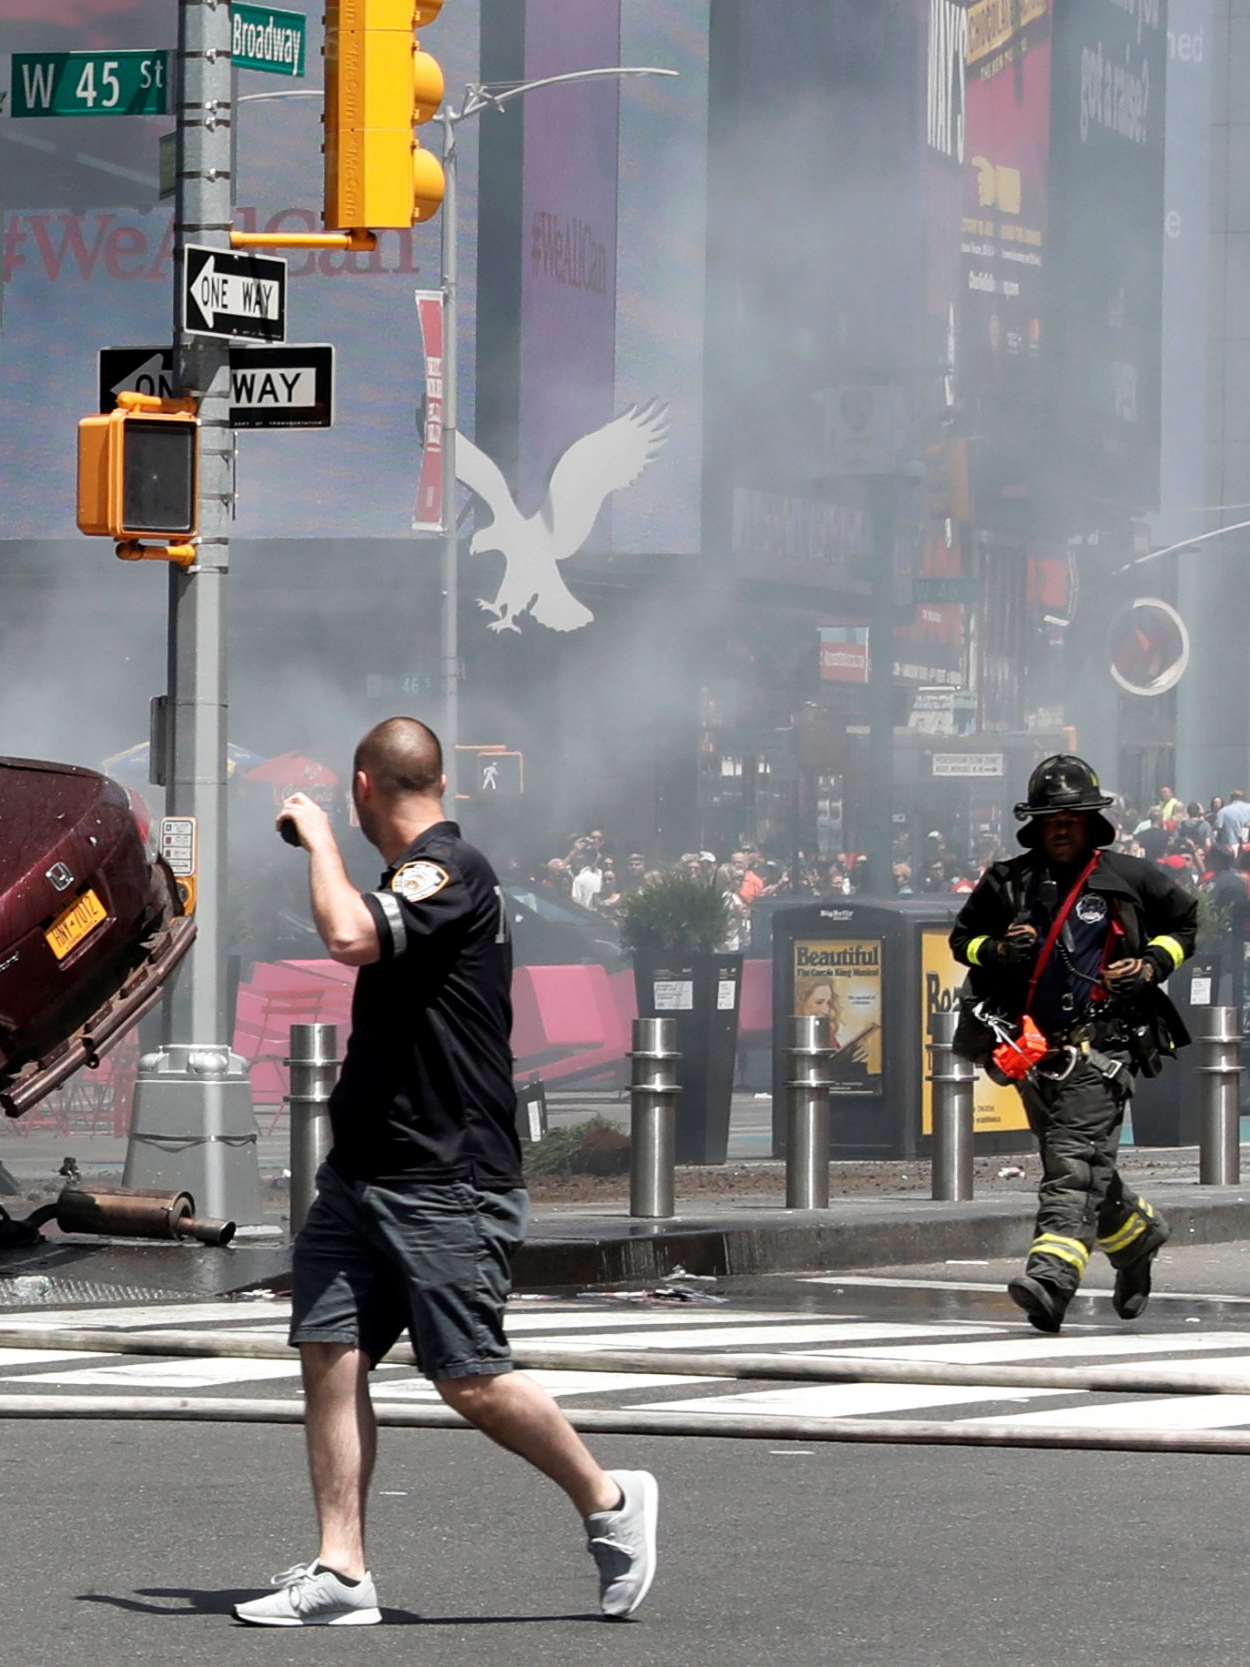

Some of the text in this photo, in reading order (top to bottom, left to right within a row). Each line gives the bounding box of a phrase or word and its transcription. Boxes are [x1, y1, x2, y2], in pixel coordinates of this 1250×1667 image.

[232, 13, 301, 75] Broadway
[22, 59, 164, 109] W 45 St
[200, 275, 273, 317] ONE WAY
[135, 373, 302, 404] ON WAY
[402, 677, 420, 695] 46
[796, 945, 879, 966] Beautiful
[797, 968, 811, 976] The
[834, 968, 852, 977] King
